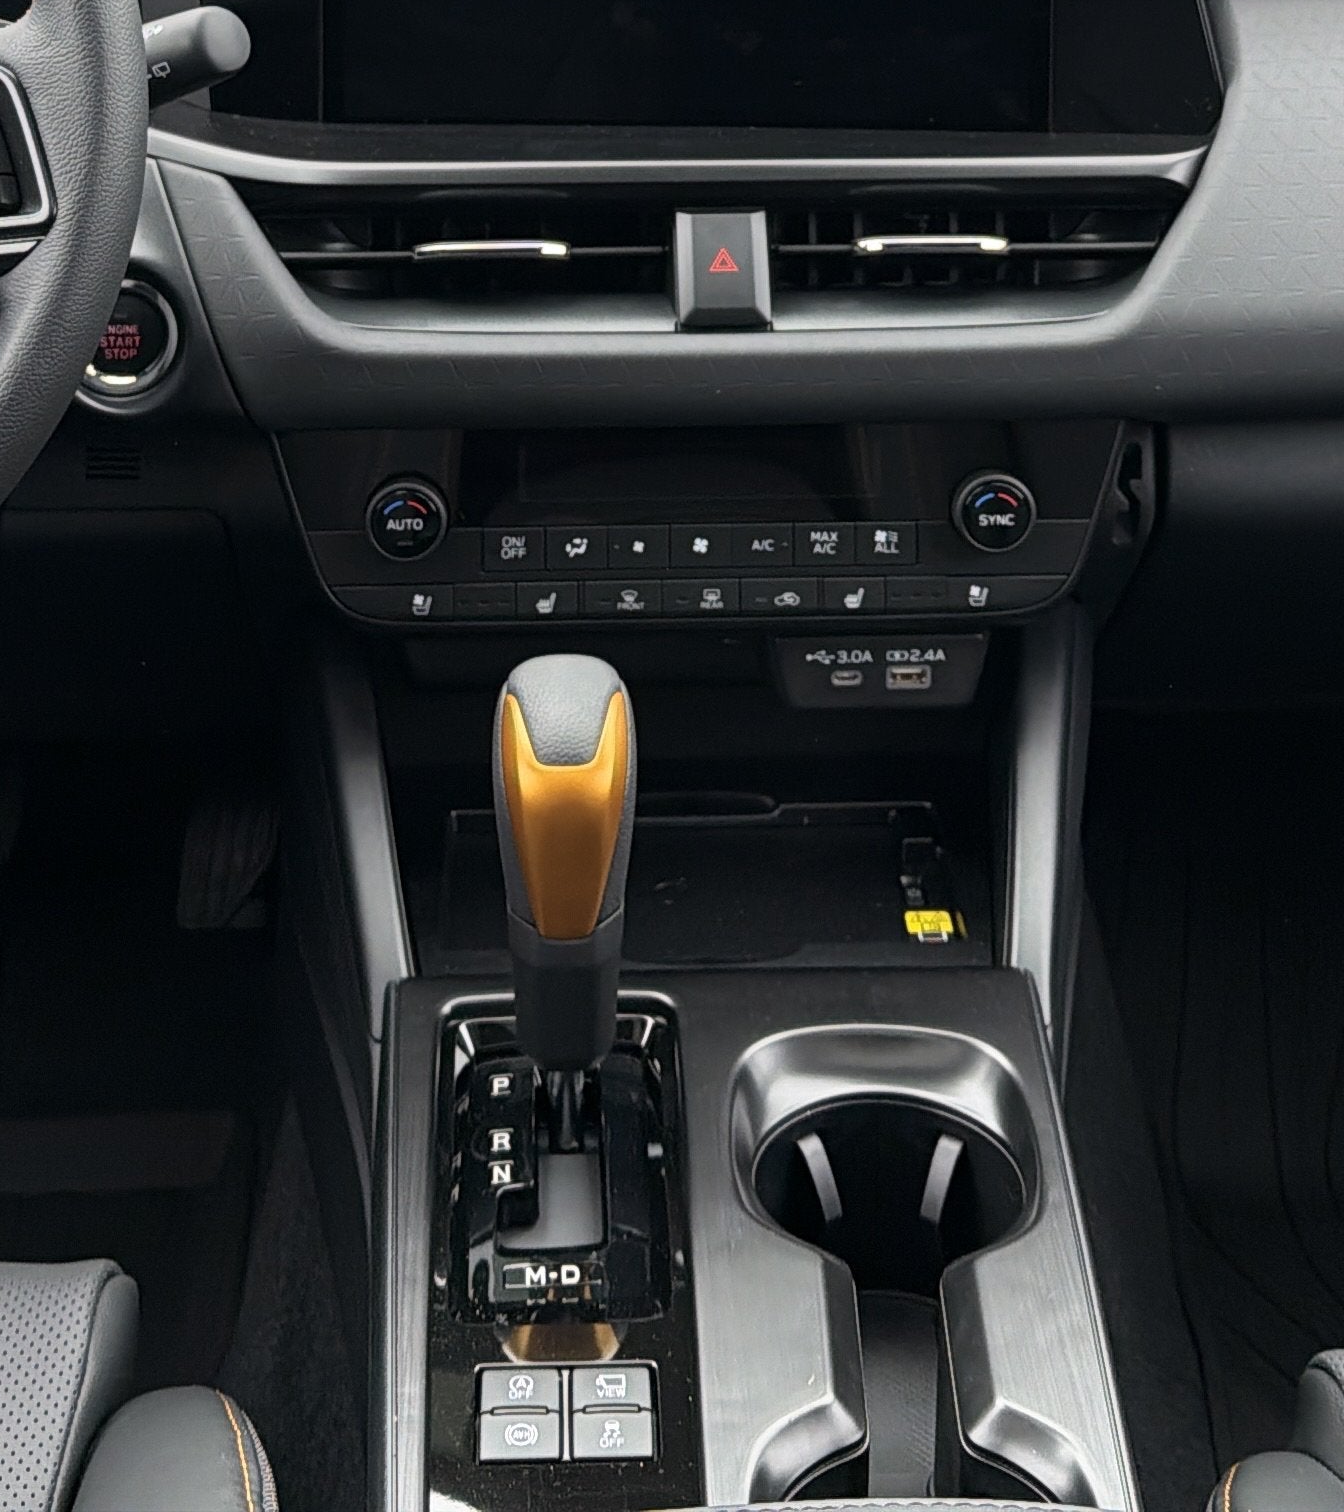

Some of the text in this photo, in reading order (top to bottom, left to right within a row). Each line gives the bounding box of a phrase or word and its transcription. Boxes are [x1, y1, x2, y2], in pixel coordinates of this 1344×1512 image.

[107, 324, 140, 335] NGINE
[100, 335, 142, 348] START
[104, 348, 138, 360] STOP
[386, 518, 424, 531] AUTO
[978, 513, 1016, 527] SYNC
[809, 531, 839, 542] MAX
[751, 538, 775, 552] A/C
[812, 542, 837, 555] A/C
[873, 542, 900, 554] ALL
[500, 547, 527, 559] OFF
[836, 650, 873, 663] 3.0A
[909, 648, 946, 662] 2.4A
[491, 1076, 510, 1093] P
[492, 1132, 512, 1150] R
[492, 1165, 512, 1183] N
[508, 1390, 534, 1399] OFF
[596, 1388, 626, 1398] VIEW
[599, 1437, 625, 1448] OFF
